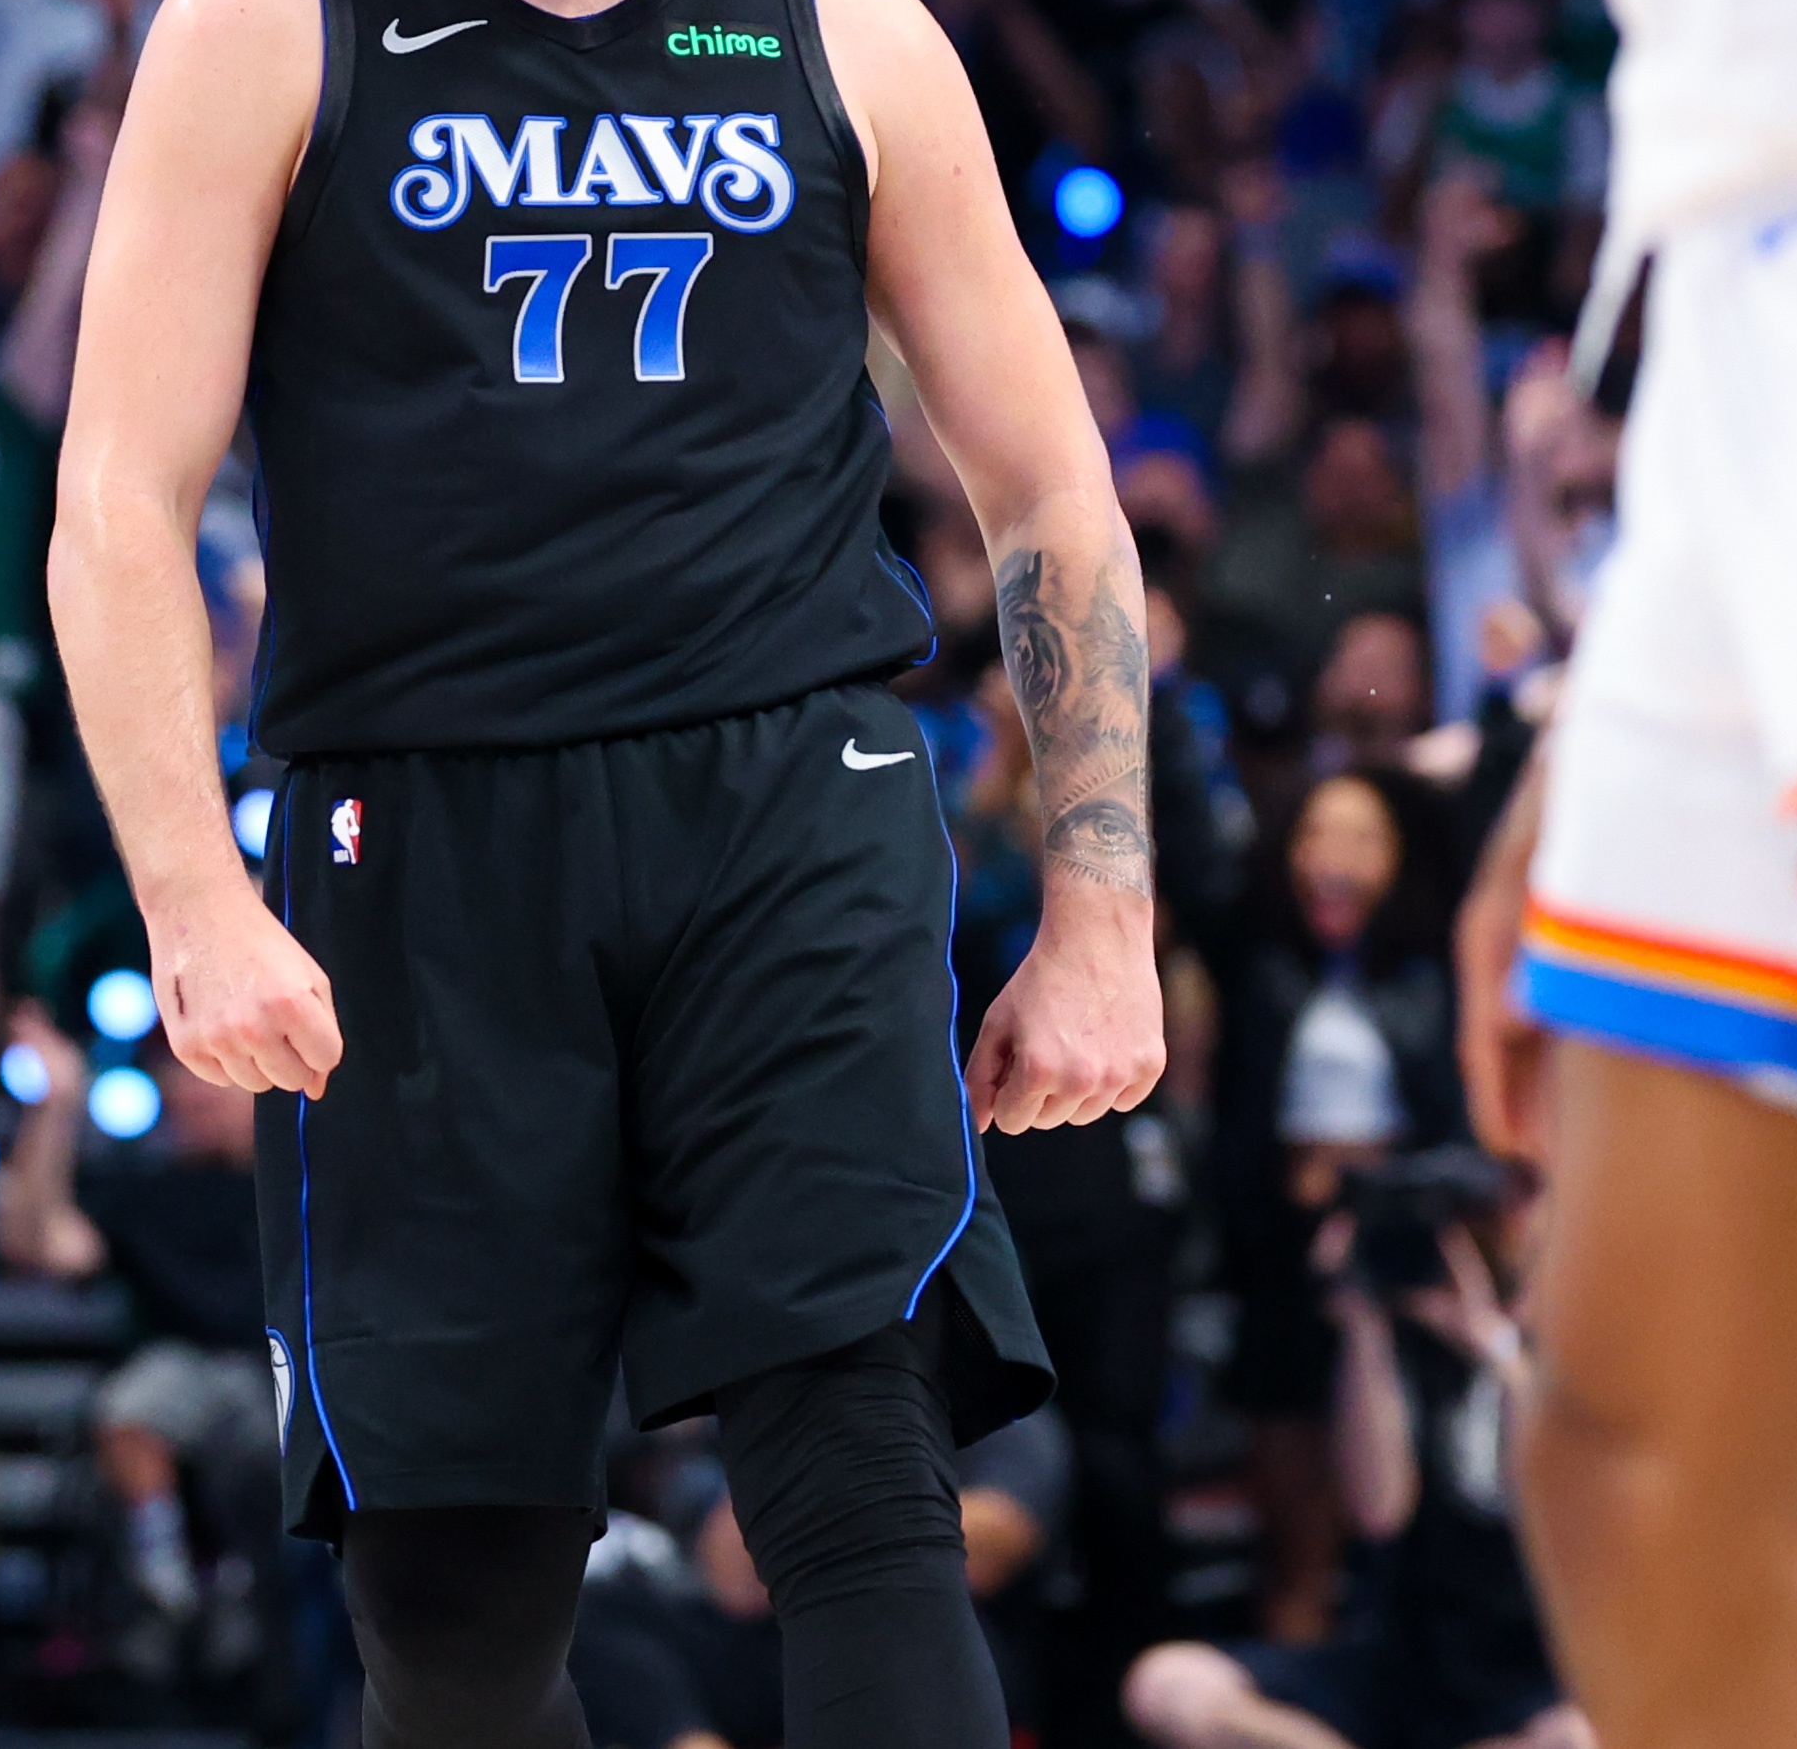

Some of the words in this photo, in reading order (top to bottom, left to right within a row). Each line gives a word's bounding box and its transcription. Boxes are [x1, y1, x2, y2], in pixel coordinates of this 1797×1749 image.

[667, 25, 782, 58] chime
[390, 112, 796, 233] MAVS
[483, 232, 714, 383] 77
